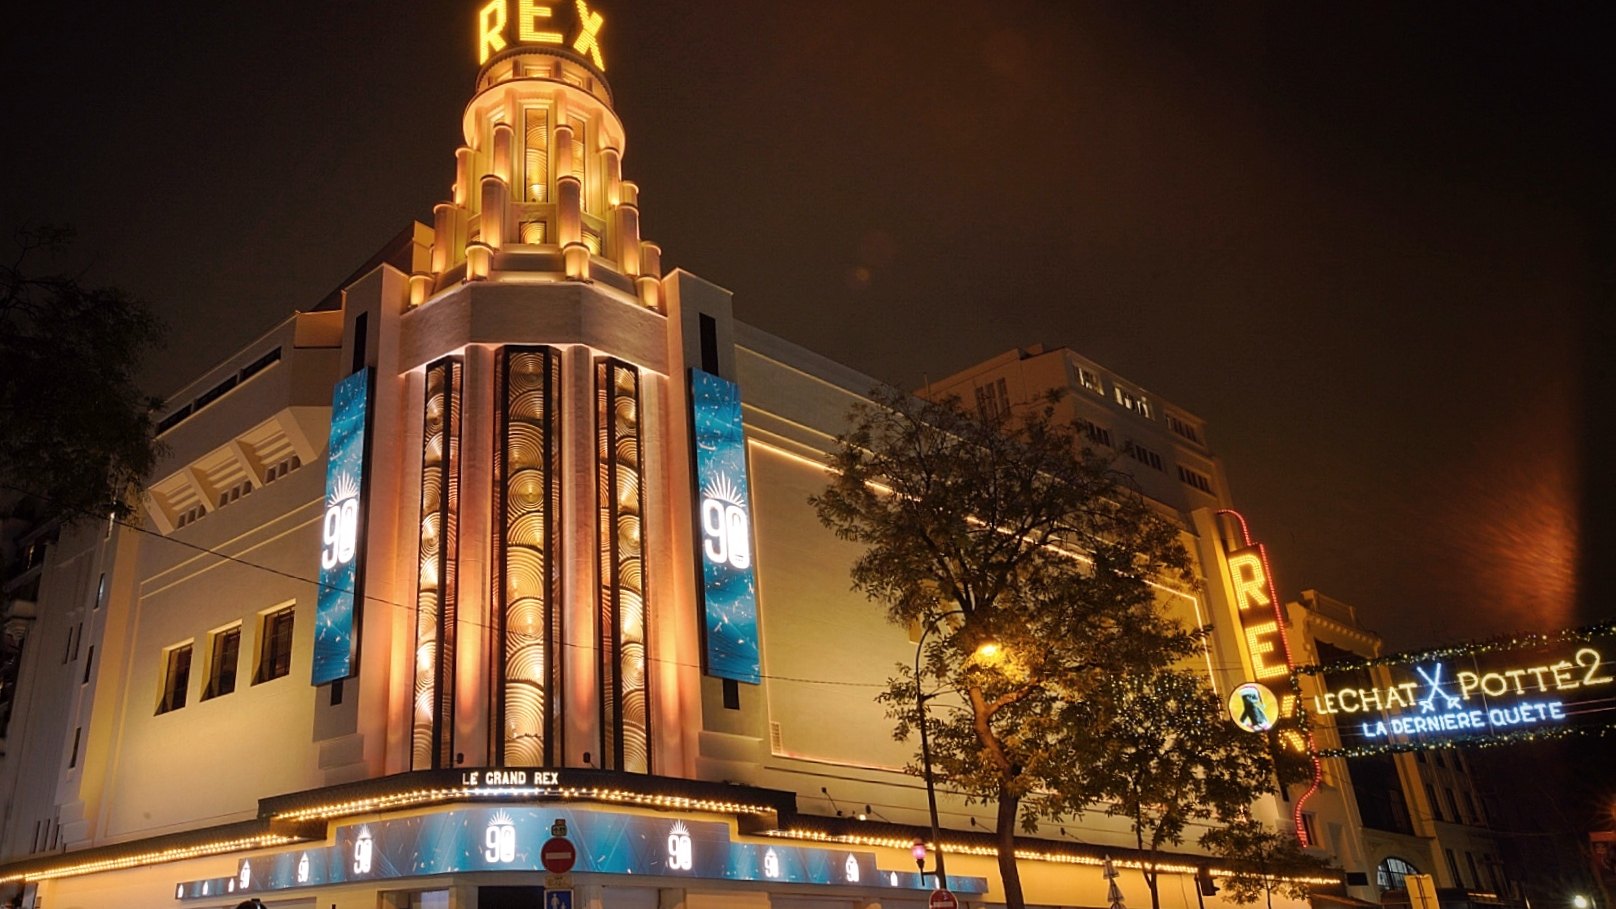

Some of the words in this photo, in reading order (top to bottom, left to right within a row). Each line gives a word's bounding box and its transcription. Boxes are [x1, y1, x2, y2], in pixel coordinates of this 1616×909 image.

[479, 0, 605, 72] REX
[321, 498, 358, 570] 90
[702, 498, 750, 569] 90
[1456, 660, 1570, 700] POTTÉ
[1575, 648, 1614, 686] 2
[1362, 720, 1388, 737] LA
[462, 771, 479, 786] LE
[485, 771, 527, 785] GRAND
[534, 772, 559, 785] REX
[353, 838, 373, 875] 90
[484, 825, 516, 863] 90
[667, 834, 692, 870] 90
